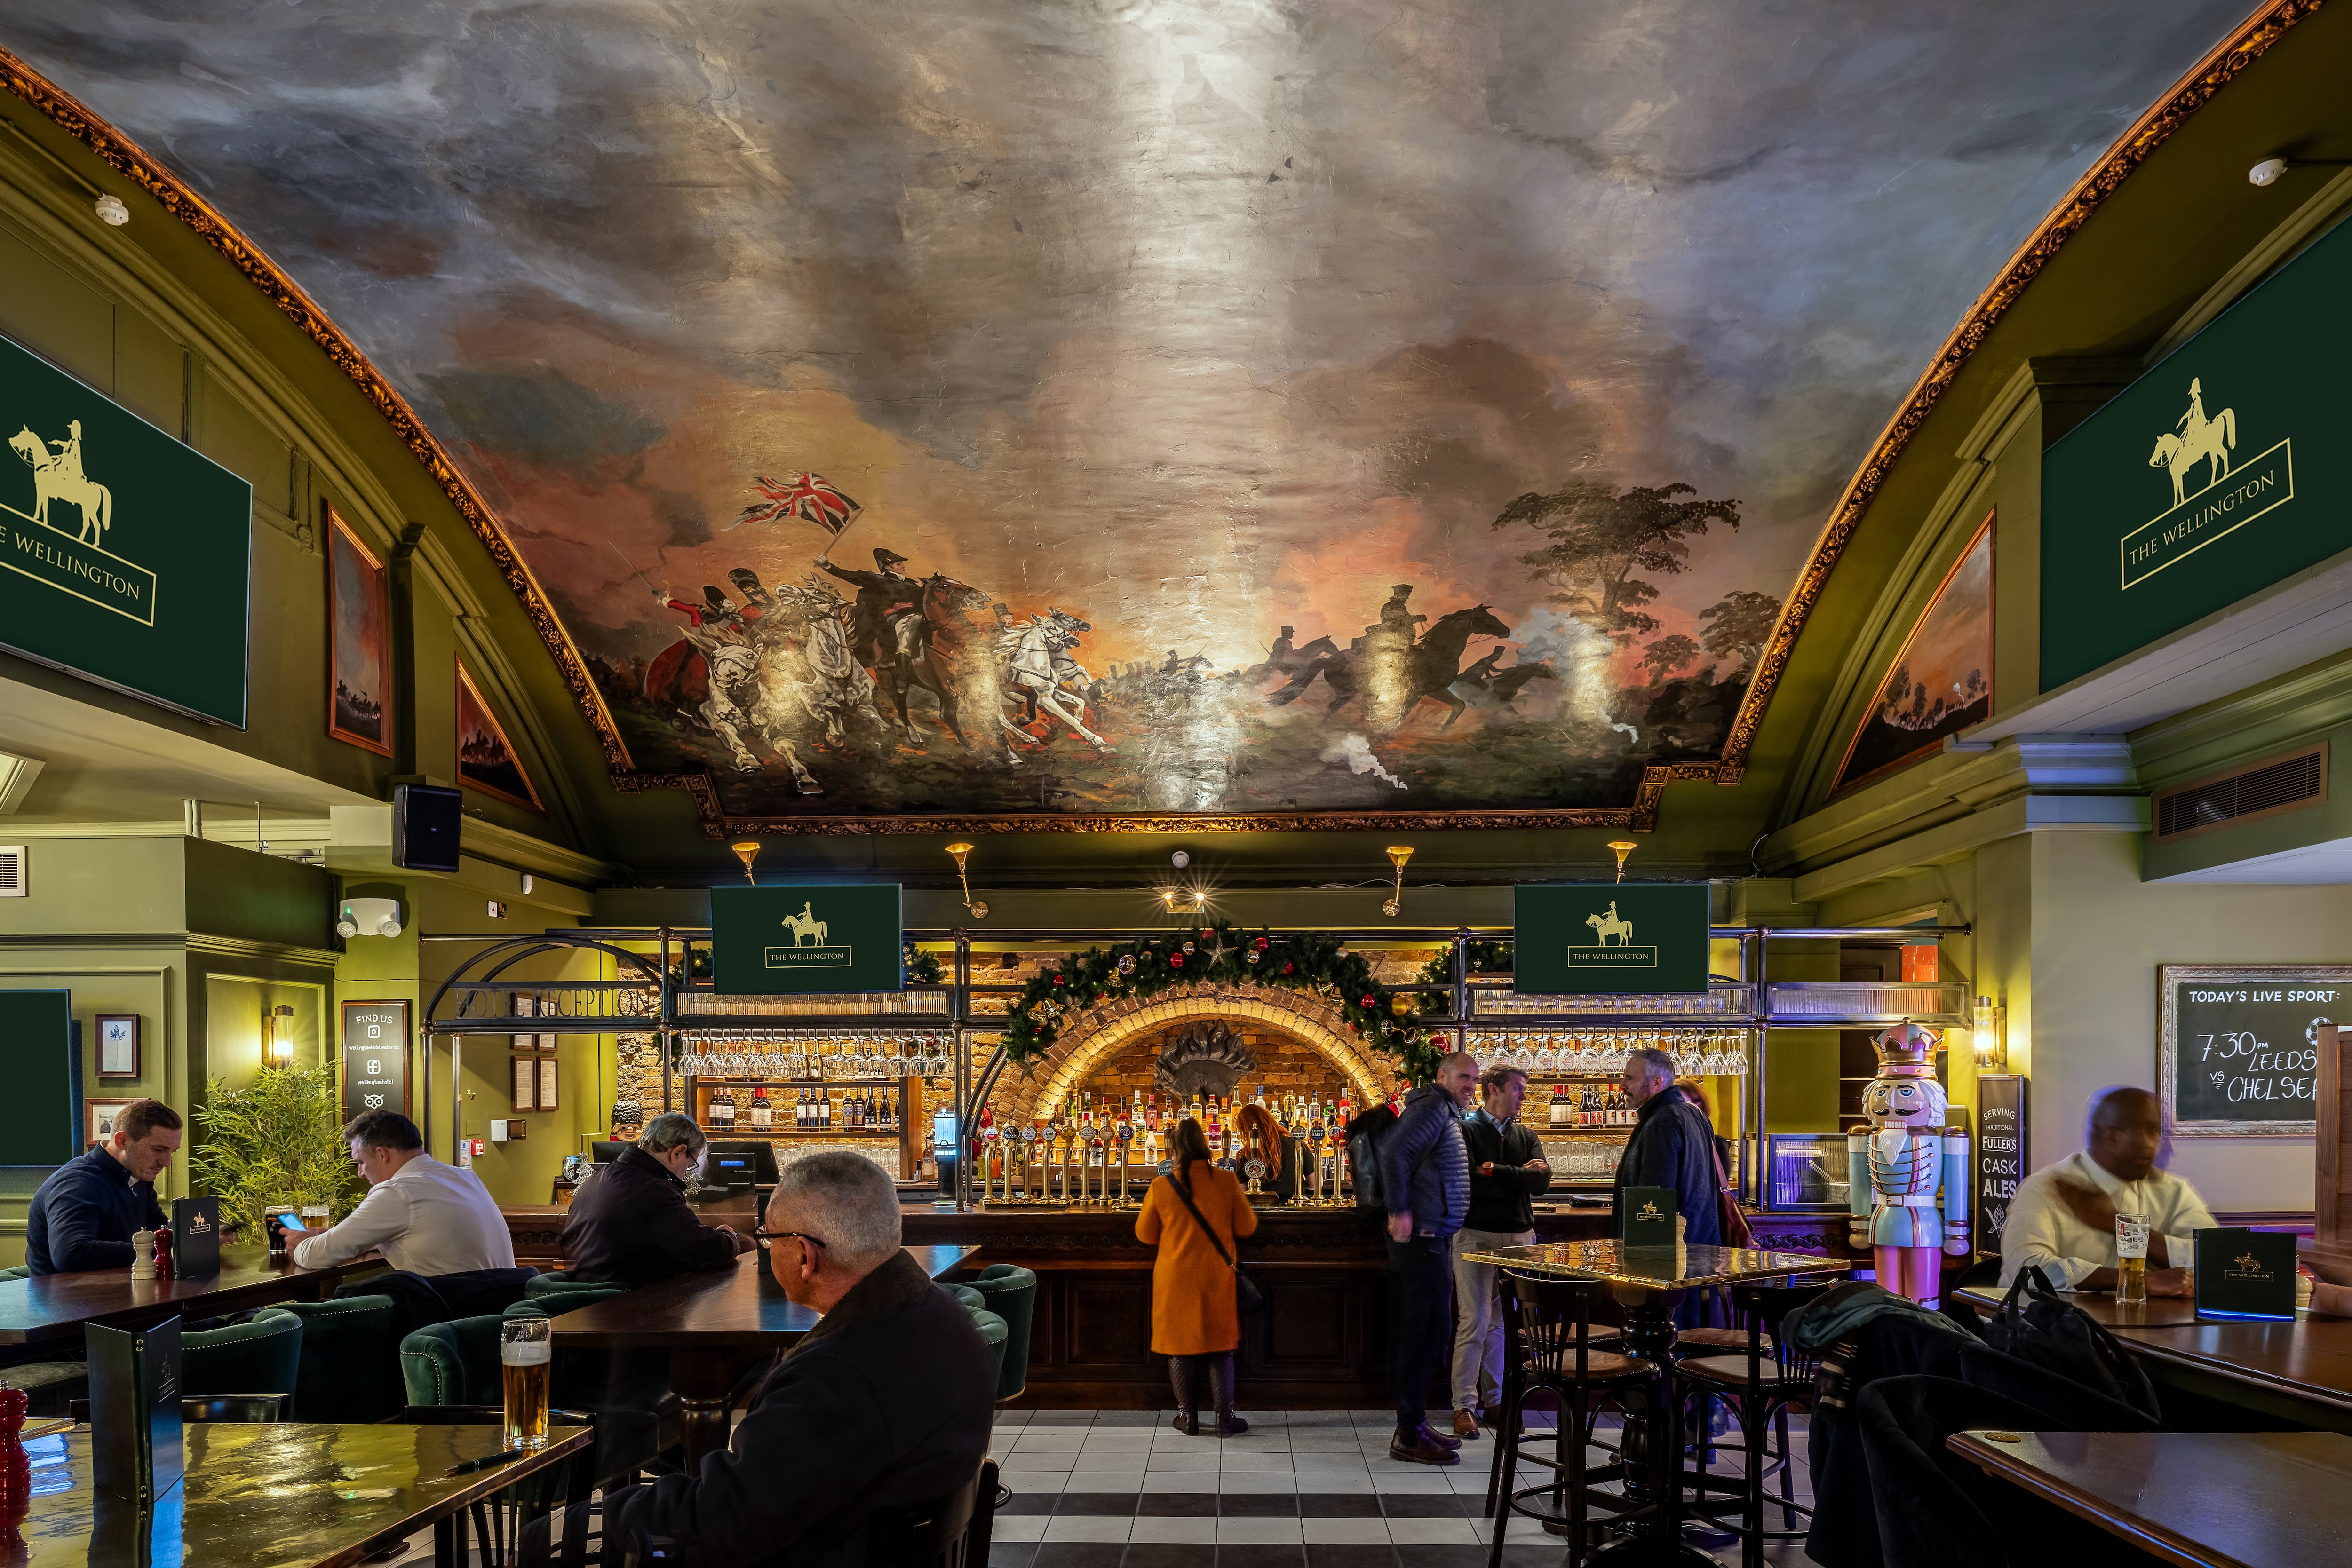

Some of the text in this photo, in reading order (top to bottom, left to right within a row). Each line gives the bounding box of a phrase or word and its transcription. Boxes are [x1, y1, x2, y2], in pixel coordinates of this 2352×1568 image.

[2129, 470, 2274, 565] THE WELLINGTON
[15, 532, 139, 601] WELLINGTON
[455, 988, 524, 1018] HOTEL
[533, 988, 650, 1017] RECEPTION
[2189, 990, 2340, 1003] TODAY'S LIVE SPORT:
[356, 1014, 393, 1024] FIND US
[2197, 1031, 2256, 1062] 7:30
[2248, 1049, 2317, 1072] LEEDS
[2209, 1070, 2225, 1082] VS
[1983, 1108, 2015, 1121] SERVING
[1983, 1136, 2017, 1152] FULLER'S
[1983, 1158, 2017, 1175] CASK
[1983, 1179, 2017, 1199] ALES
